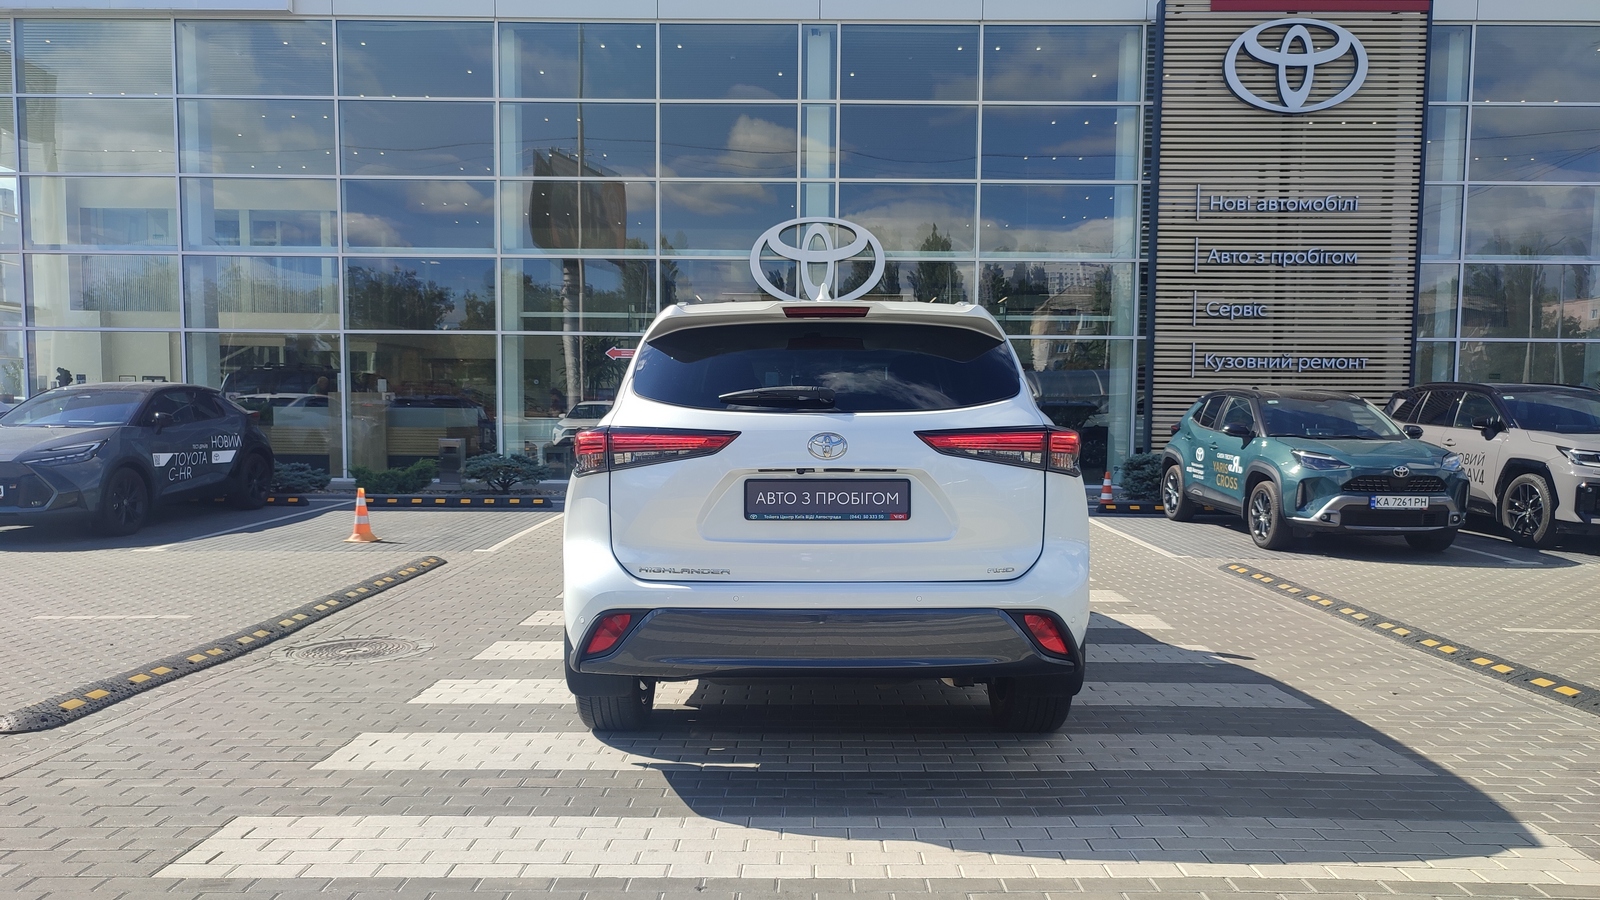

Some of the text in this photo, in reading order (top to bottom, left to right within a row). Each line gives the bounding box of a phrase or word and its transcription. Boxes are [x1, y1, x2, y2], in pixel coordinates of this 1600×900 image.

[1209, 194, 1360, 212] Нові автомобілі
[1207, 248, 1358, 268] Авто з пробігом
[1205, 301, 1268, 320] Сервіс
[1204, 353, 1369, 372] Кузовний ремонт
[211, 433, 243, 448] НОВИЙ
[173, 452, 208, 466] TOYOTA
[1458, 452, 1485, 466] ОВИЙ
[168, 466, 192, 481] C-HR
[1213, 461, 1229, 474] YARIS
[1216, 473, 1238, 490] CROSS
[1463, 467, 1485, 485] AV4
[755, 491, 899, 505] АВТО З ПРОБІГОМ
[1376, 497, 1427, 507] KA 7261 PH
[639, 566, 731, 575] HIGHLANDER
